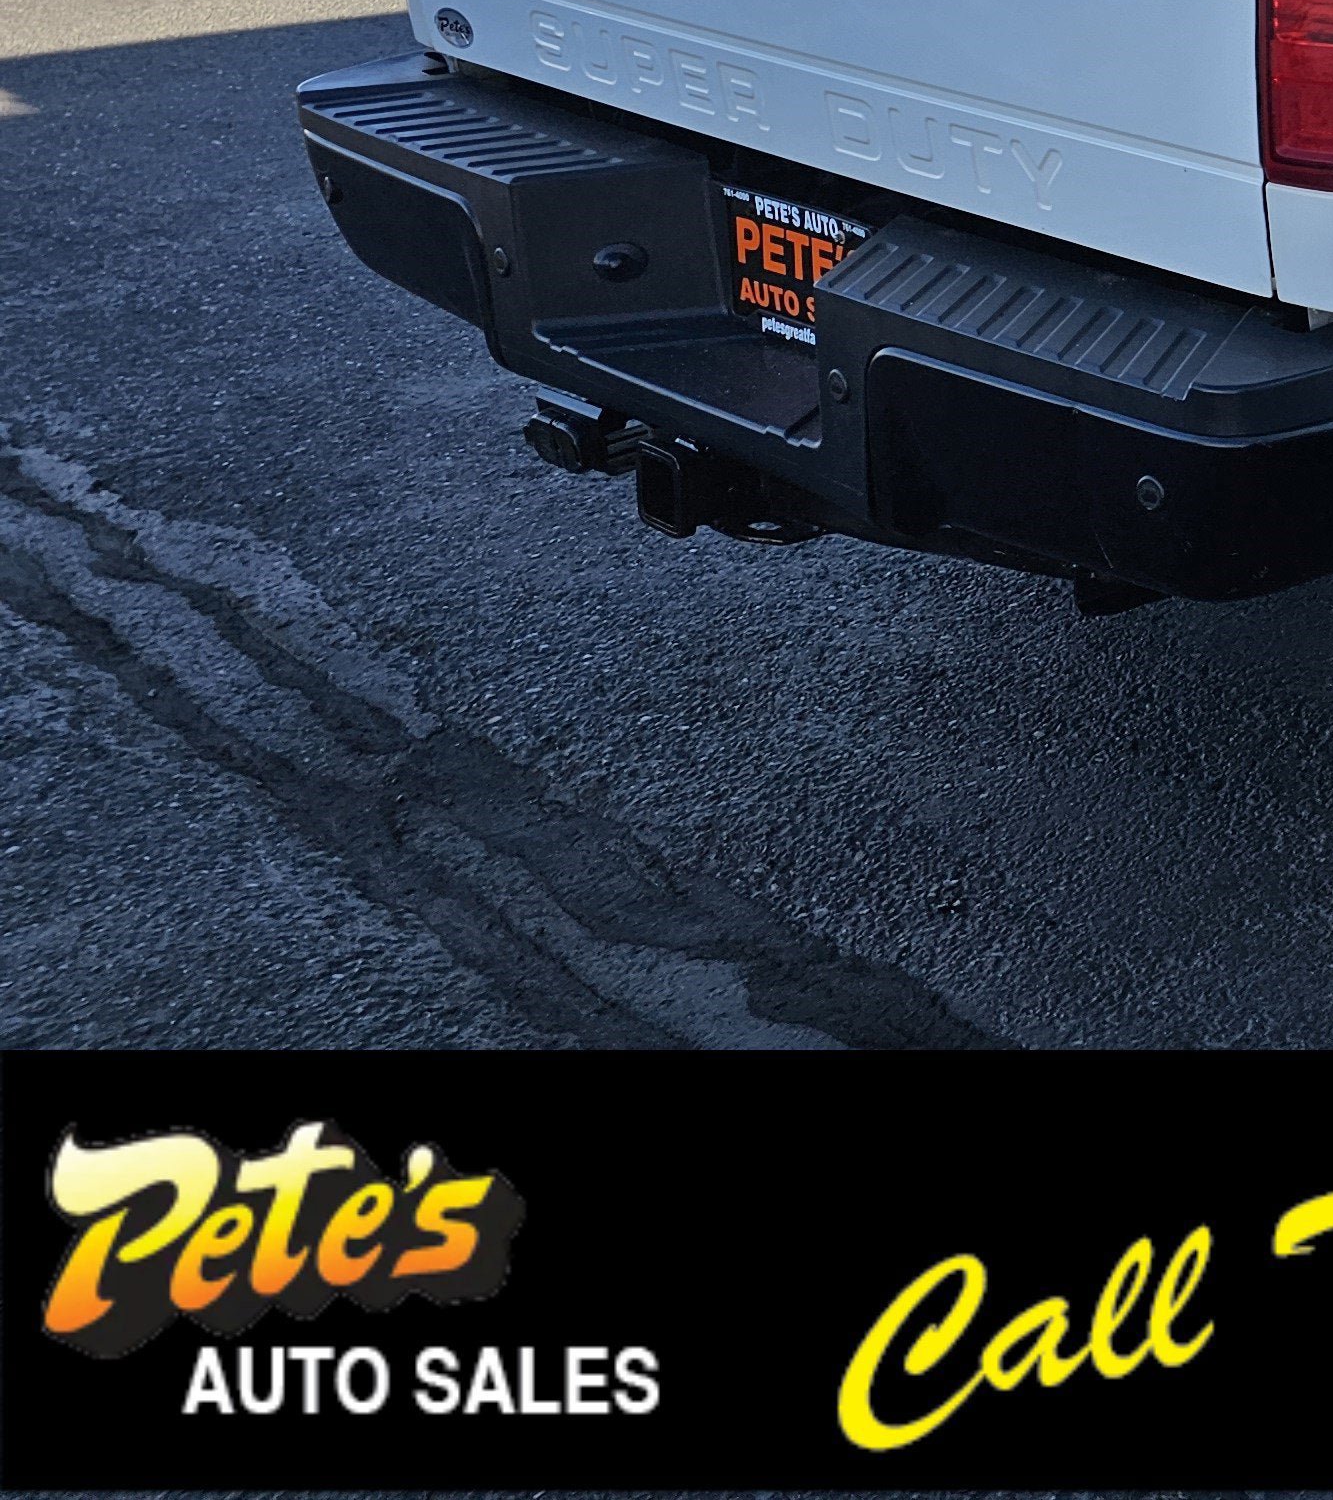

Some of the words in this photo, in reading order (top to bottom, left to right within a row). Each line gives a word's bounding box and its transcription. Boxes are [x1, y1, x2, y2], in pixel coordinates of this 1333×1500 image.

[529, 9, 771, 132] SUPER
[823, 89, 1063, 212] DUTY
[754, 195, 801, 228] PETE'S
[804, 211, 839, 242] AUTO
[740, 277, 800, 317] AUTO
